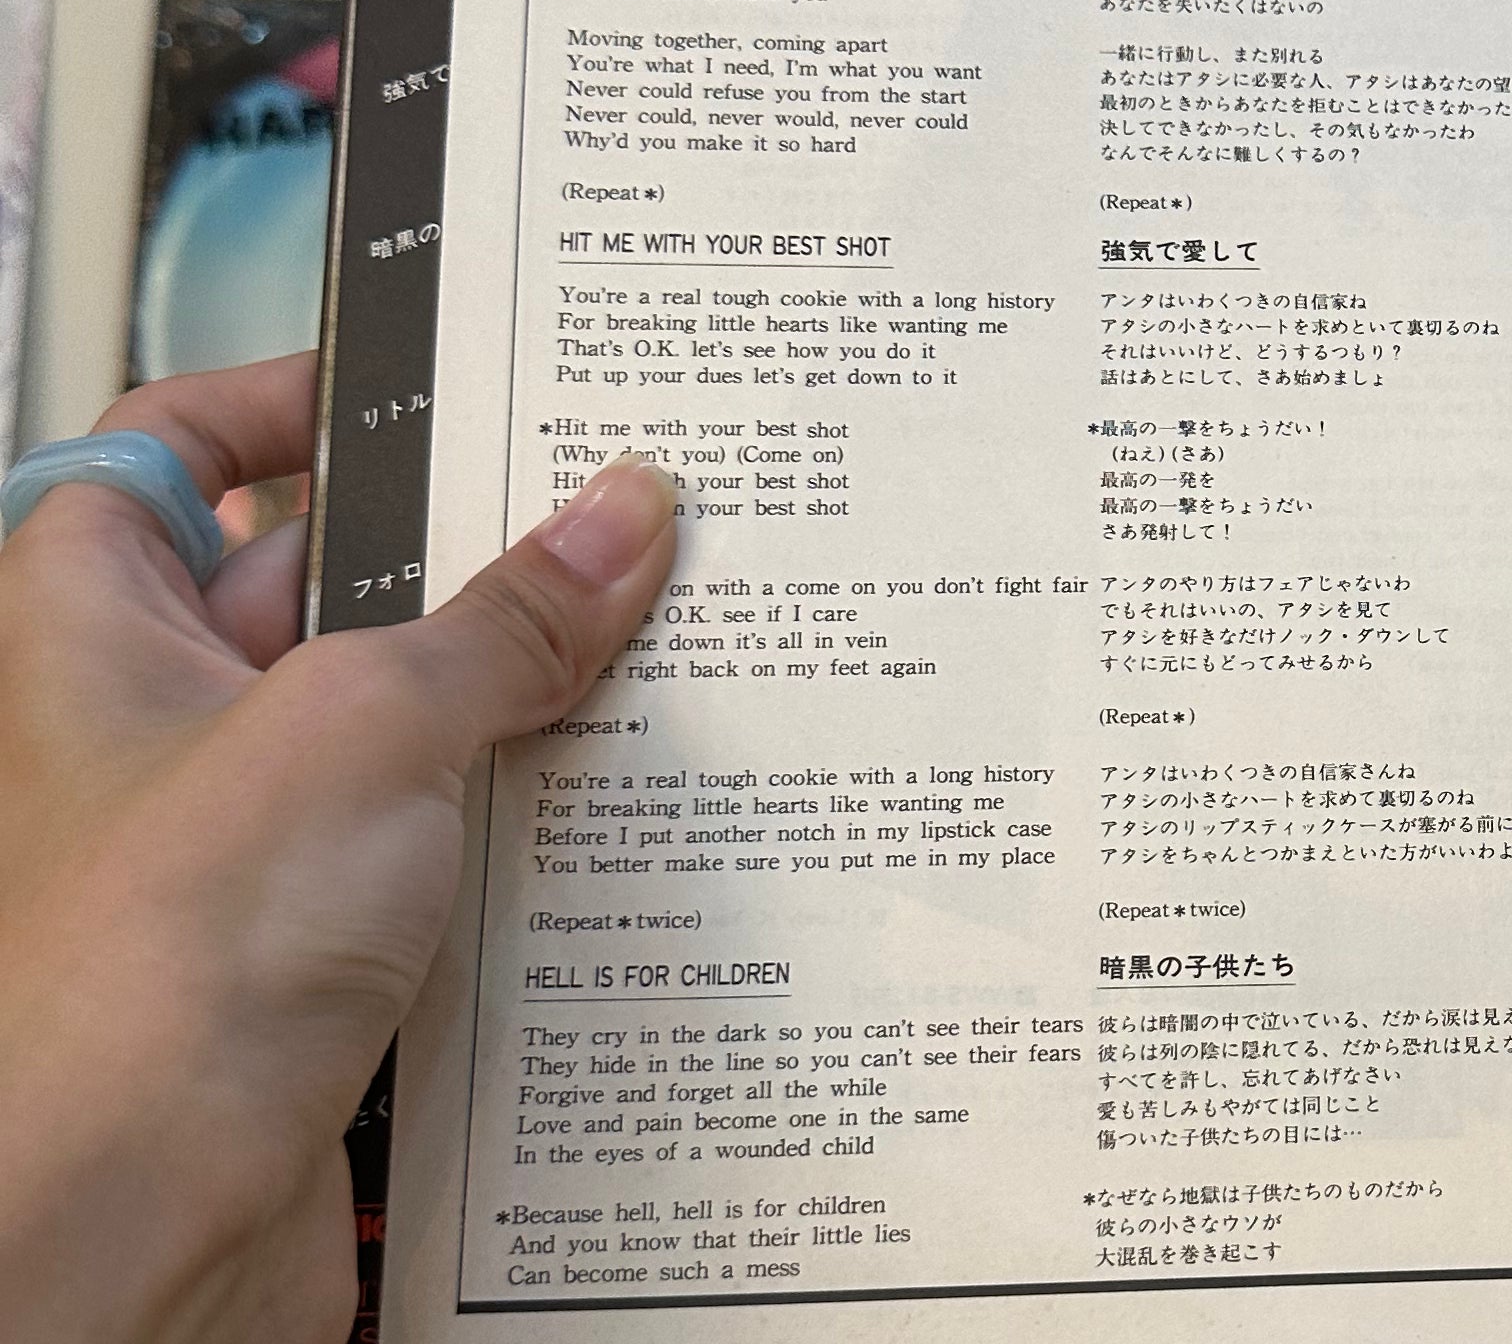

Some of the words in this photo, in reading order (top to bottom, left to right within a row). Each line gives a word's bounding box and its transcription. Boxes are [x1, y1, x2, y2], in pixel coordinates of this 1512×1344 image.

[567, 28, 644, 51] Moving
[654, 32, 742, 52] together,
[752, 34, 826, 55] coming
[835, 38, 888, 56] apart
[560, 231, 593, 252] HIT
[603, 232, 635, 253] ME
[643, 233, 695, 254] WITH
[705, 234, 763, 255] YOUR
[772, 235, 827, 256] BEST
[836, 236, 892, 257] SHOT
[1101, 239, 1258, 263] 強気で愛して
[1099, 471, 1215, 489] 最高の一発を
[627, 639, 657, 651] me
[668, 633, 725, 651] down
[735, 632, 767, 650] it's
[777, 631, 803, 650] all
[814, 631, 834, 649] in
[844, 630, 888, 649] vein
[526, 966, 584, 989] HELL
[595, 965, 614, 988] IS
[624, 964, 670, 988] FOR
[680, 961, 790, 987] CHILDREN
[1099, 953, 1294, 980] 暗黒の子供たち
[514, 1145, 536, 1164] In
[549, 1144, 583, 1164] the
[595, 1148, 644, 1166] eyes
[656, 1141, 679, 1161] of
[689, 1146, 703, 1161] a
[714, 1137, 811, 1159] wounded
[822, 1135, 874, 1156] child
[1095, 1213, 1283, 1238] 彼らの小さなウソが
[1096, 1241, 1282, 1267] 大混乱を巻き起こす
